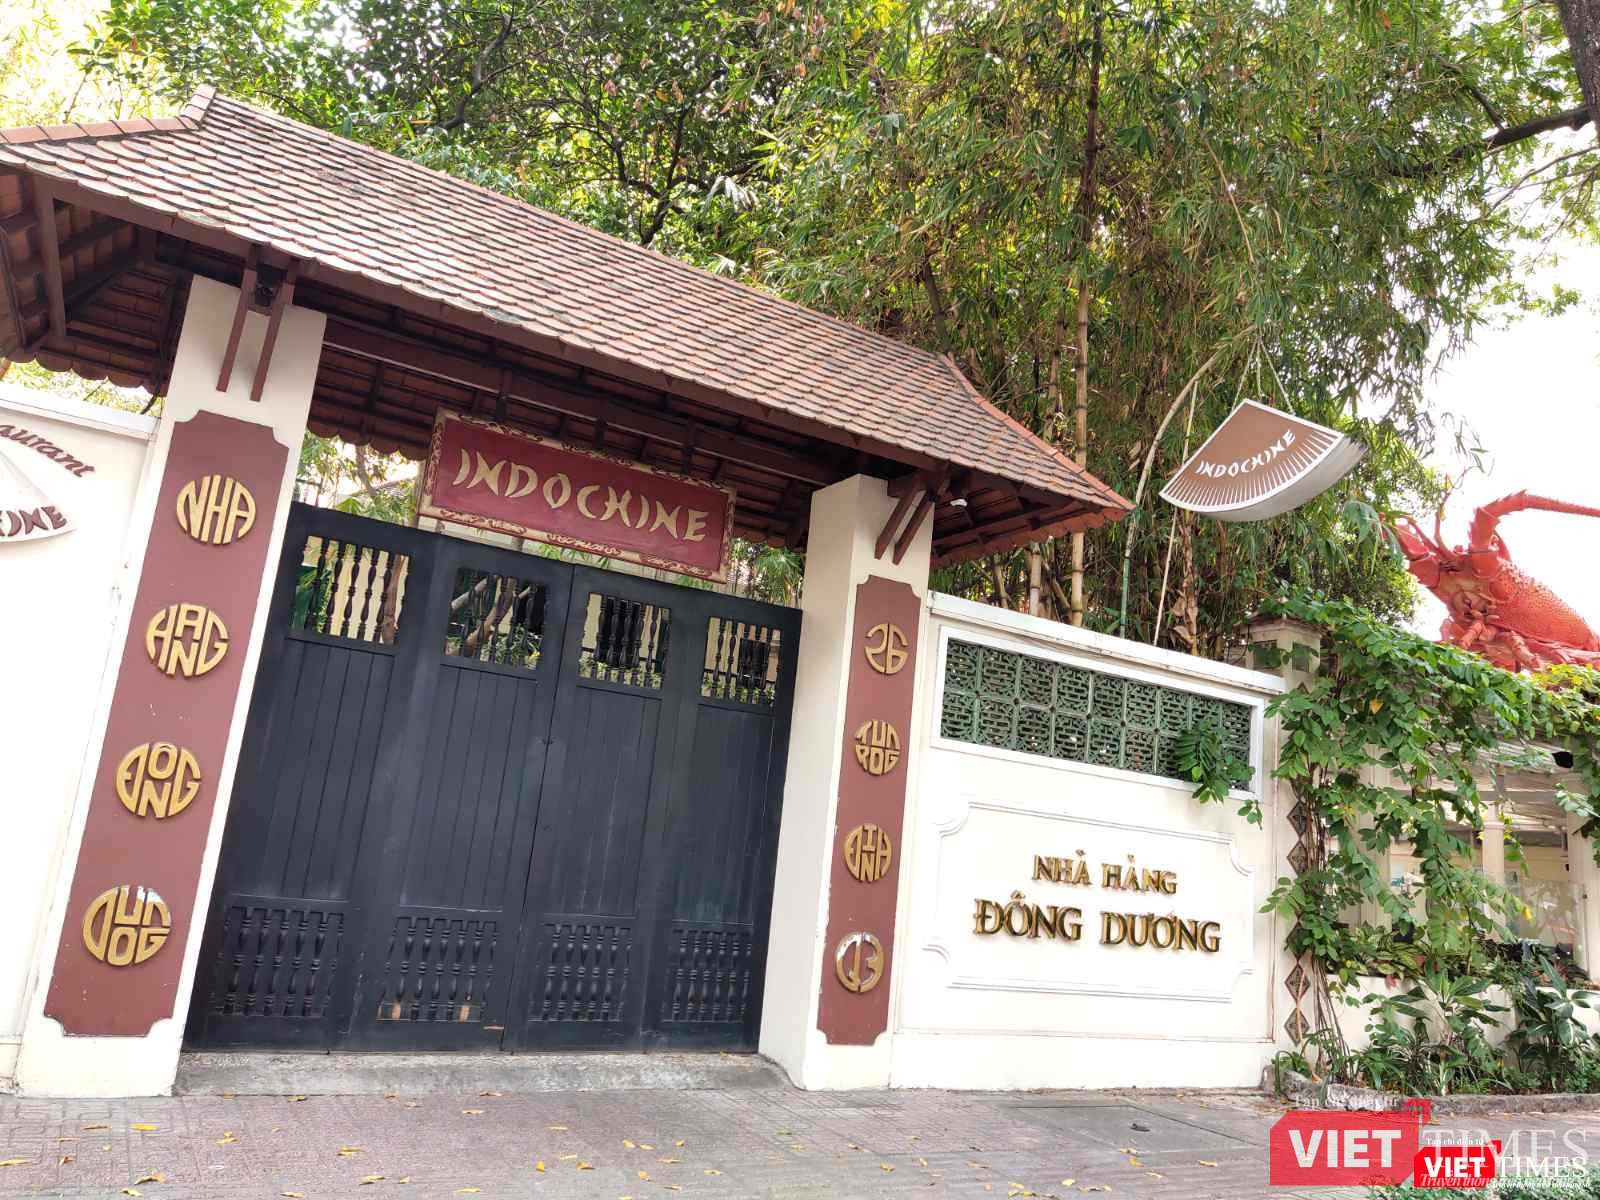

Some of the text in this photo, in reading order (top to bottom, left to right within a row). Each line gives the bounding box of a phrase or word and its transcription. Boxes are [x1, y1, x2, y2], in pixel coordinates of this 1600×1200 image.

[1196, 429, 1296, 478] INDOCHINE
[176, 475, 257, 544] NHA
[452, 449, 710, 542] INDOCHINE
[0, 506, 68, 538] INE
[864, 623, 909, 675] 26
[1032, 849, 1178, 895] NHÀ HÀNG
